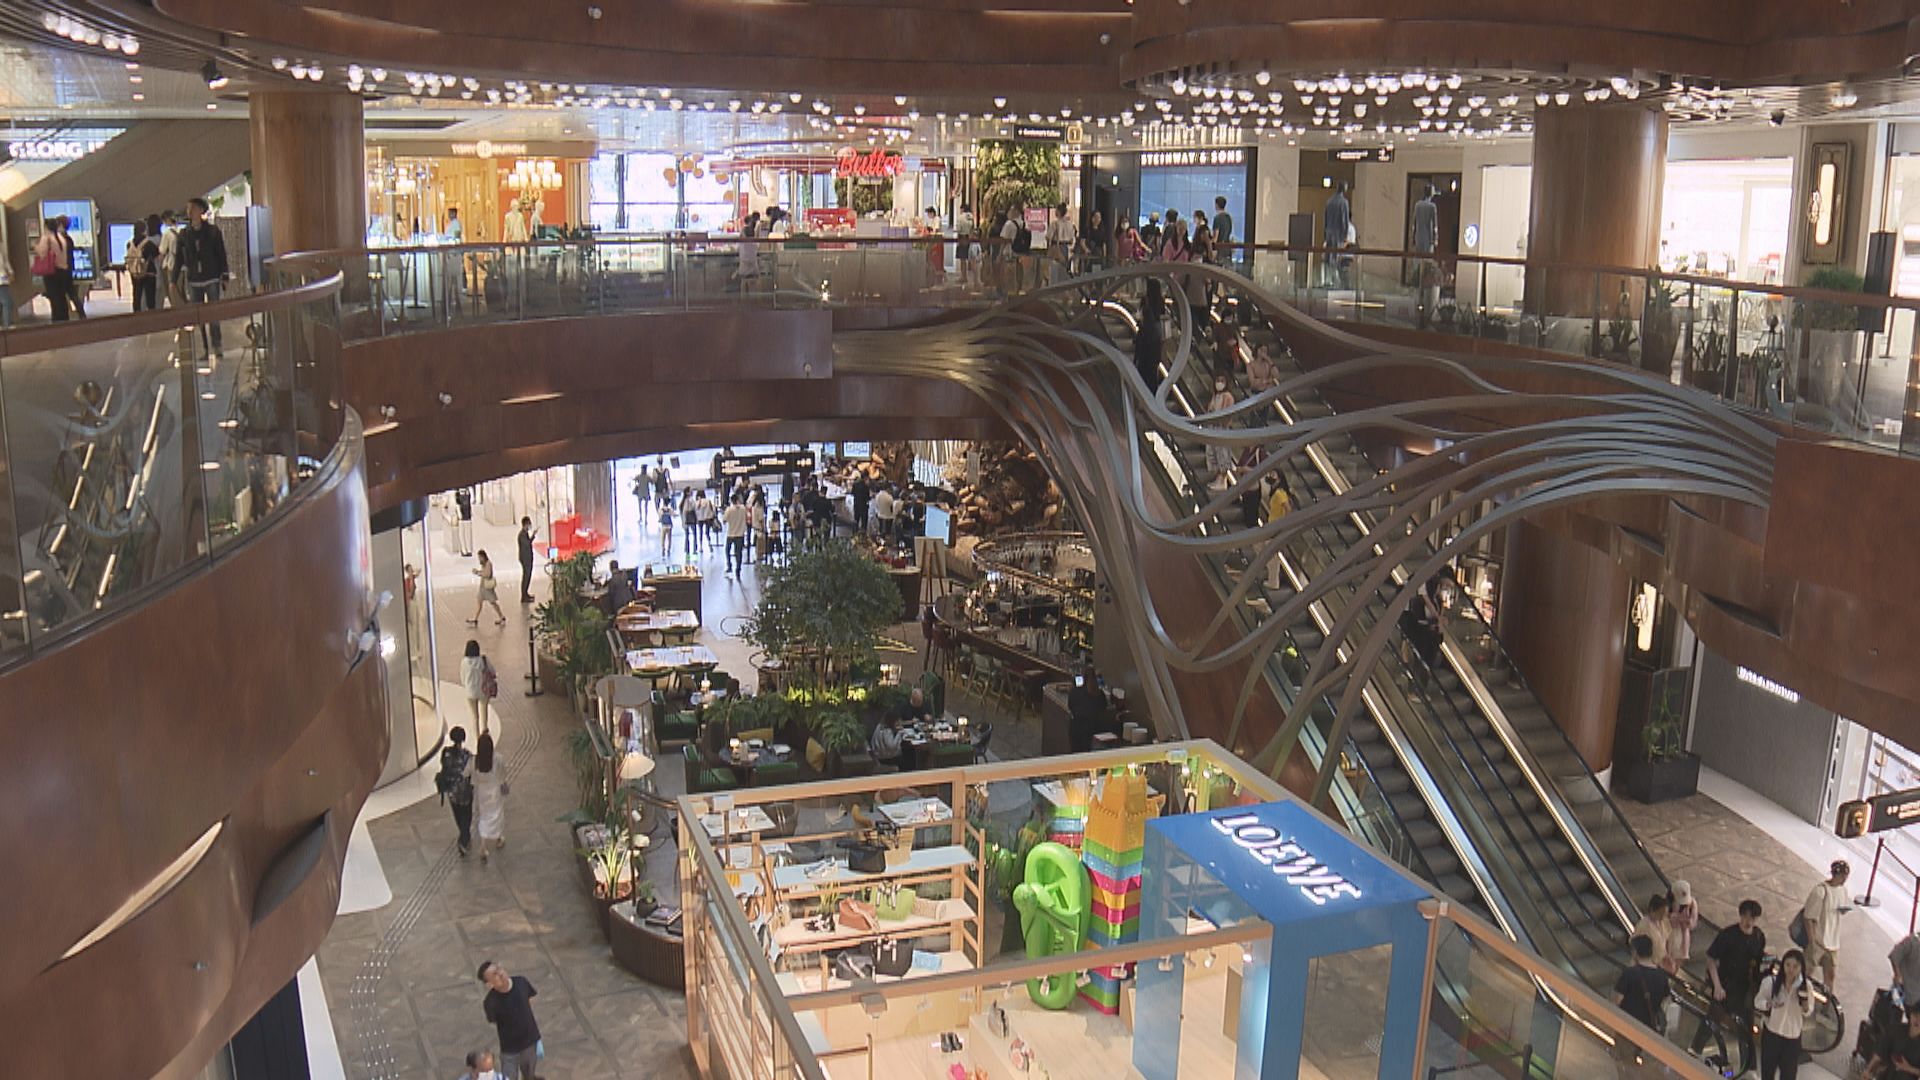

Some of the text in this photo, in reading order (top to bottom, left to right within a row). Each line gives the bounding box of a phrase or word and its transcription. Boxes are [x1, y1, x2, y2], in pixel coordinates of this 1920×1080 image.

[8, 141, 84, 160] GEORG
[1141, 149, 1242, 166] STEINWAY & SONS
[1210, 812, 1362, 906] LOEWE
